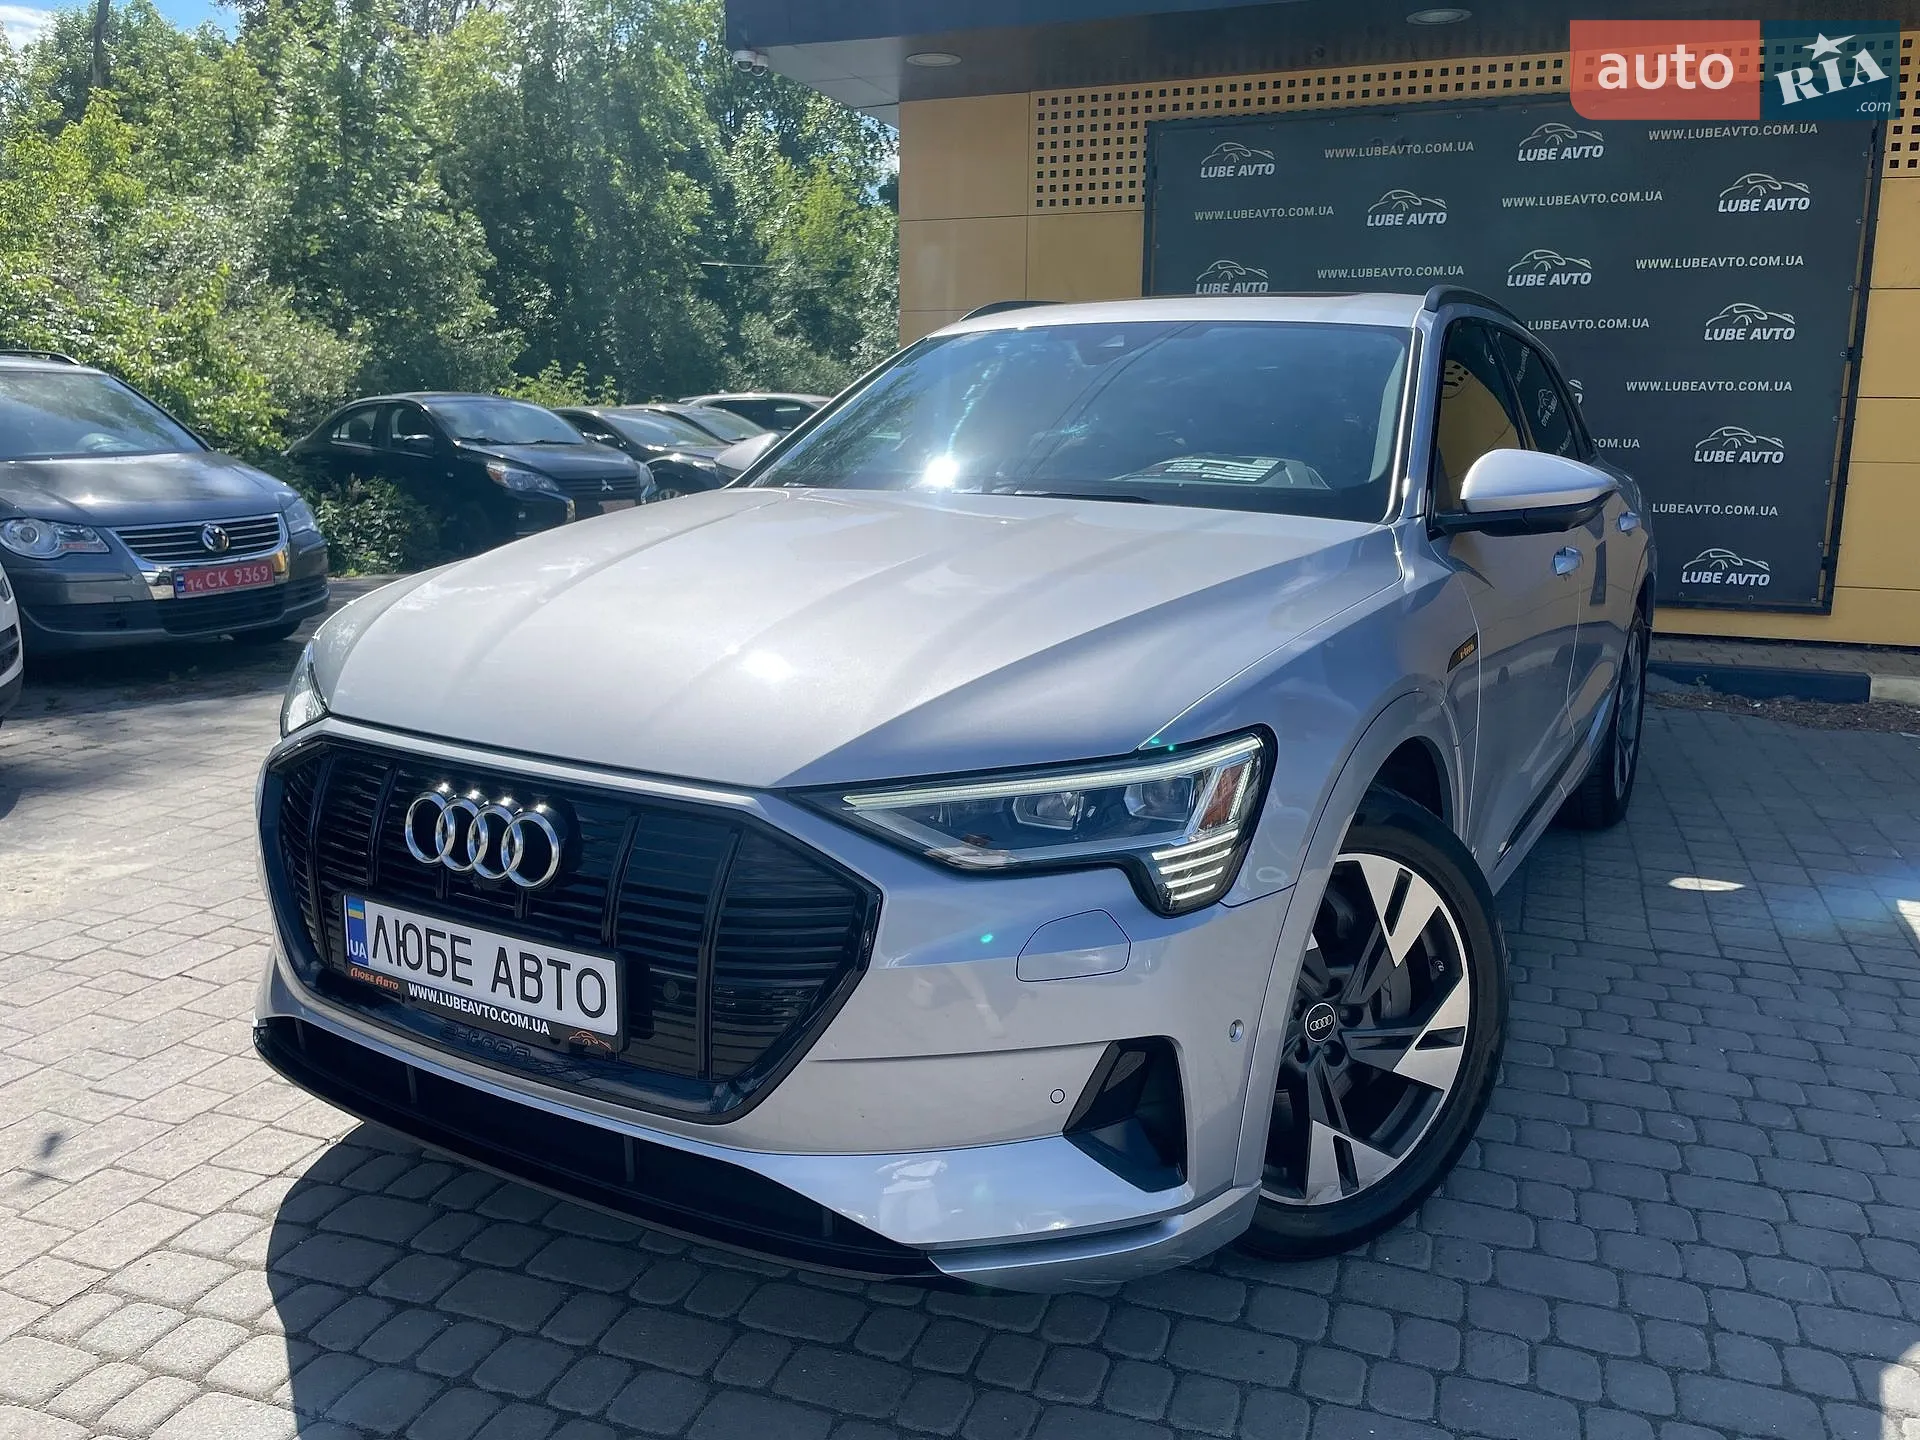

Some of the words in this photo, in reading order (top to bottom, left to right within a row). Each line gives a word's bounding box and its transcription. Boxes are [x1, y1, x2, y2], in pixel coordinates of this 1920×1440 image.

[1649, 124, 1817, 140] WWW.LUBEAVTO.COM.UA
[1325, 142, 1473, 158] WWW.LUBEAVTO.COM.UA
[1518, 148, 1557, 161] LUBE
[1561, 146, 1603, 159] AVTO
[1201, 166, 1235, 177] LUBE
[1238, 164, 1274, 176] AVTO
[1502, 191, 1662, 207] WWW.LUBEAVTO.COM.UA
[1719, 199, 1761, 212] LUBE
[1764, 198, 1809, 210] AVTO
[1195, 207, 1334, 220] WWW.LUBEAVTO.COM.UA
[1367, 213, 1404, 227] LUBE
[1407, 212, 1446, 224] AVTO
[1636, 256, 1803, 268] WWW.LUBEAVTO.COM.UA
[1318, 266, 1464, 278] WWW.LUBEAVTO.COM.UA
[1508, 274, 1547, 287] LUBE
[1549, 273, 1591, 285] AVTO
[1195, 283, 1230, 295] LUBE
[1232, 281, 1269, 293] AVTO
[1527, 318, 1651, 331] LUBEAVTO.COM.UA
[1704, 327, 1747, 341] LUBE
[1750, 328, 1795, 339] AVTO
[1626, 381, 1793, 392] WWW.LUBEAVTO.COM.UA
[1695, 451, 1736, 462] LUBE
[1738, 451, 1785, 464] AVTO
[1652, 503, 1778, 516] LUBEAVTO.COM.UA
[234, 566, 268, 584] 9369
[1682, 572, 1722, 583] LUBE
[1726, 573, 1769, 585] AVTO
[350, 939, 367, 959] UA
[372, 915, 474, 986] ЛЮБЕ
[490, 946, 606, 1019] АВТО
[408, 982, 550, 1035] WWW.LUBEAVTO.COM.UA
